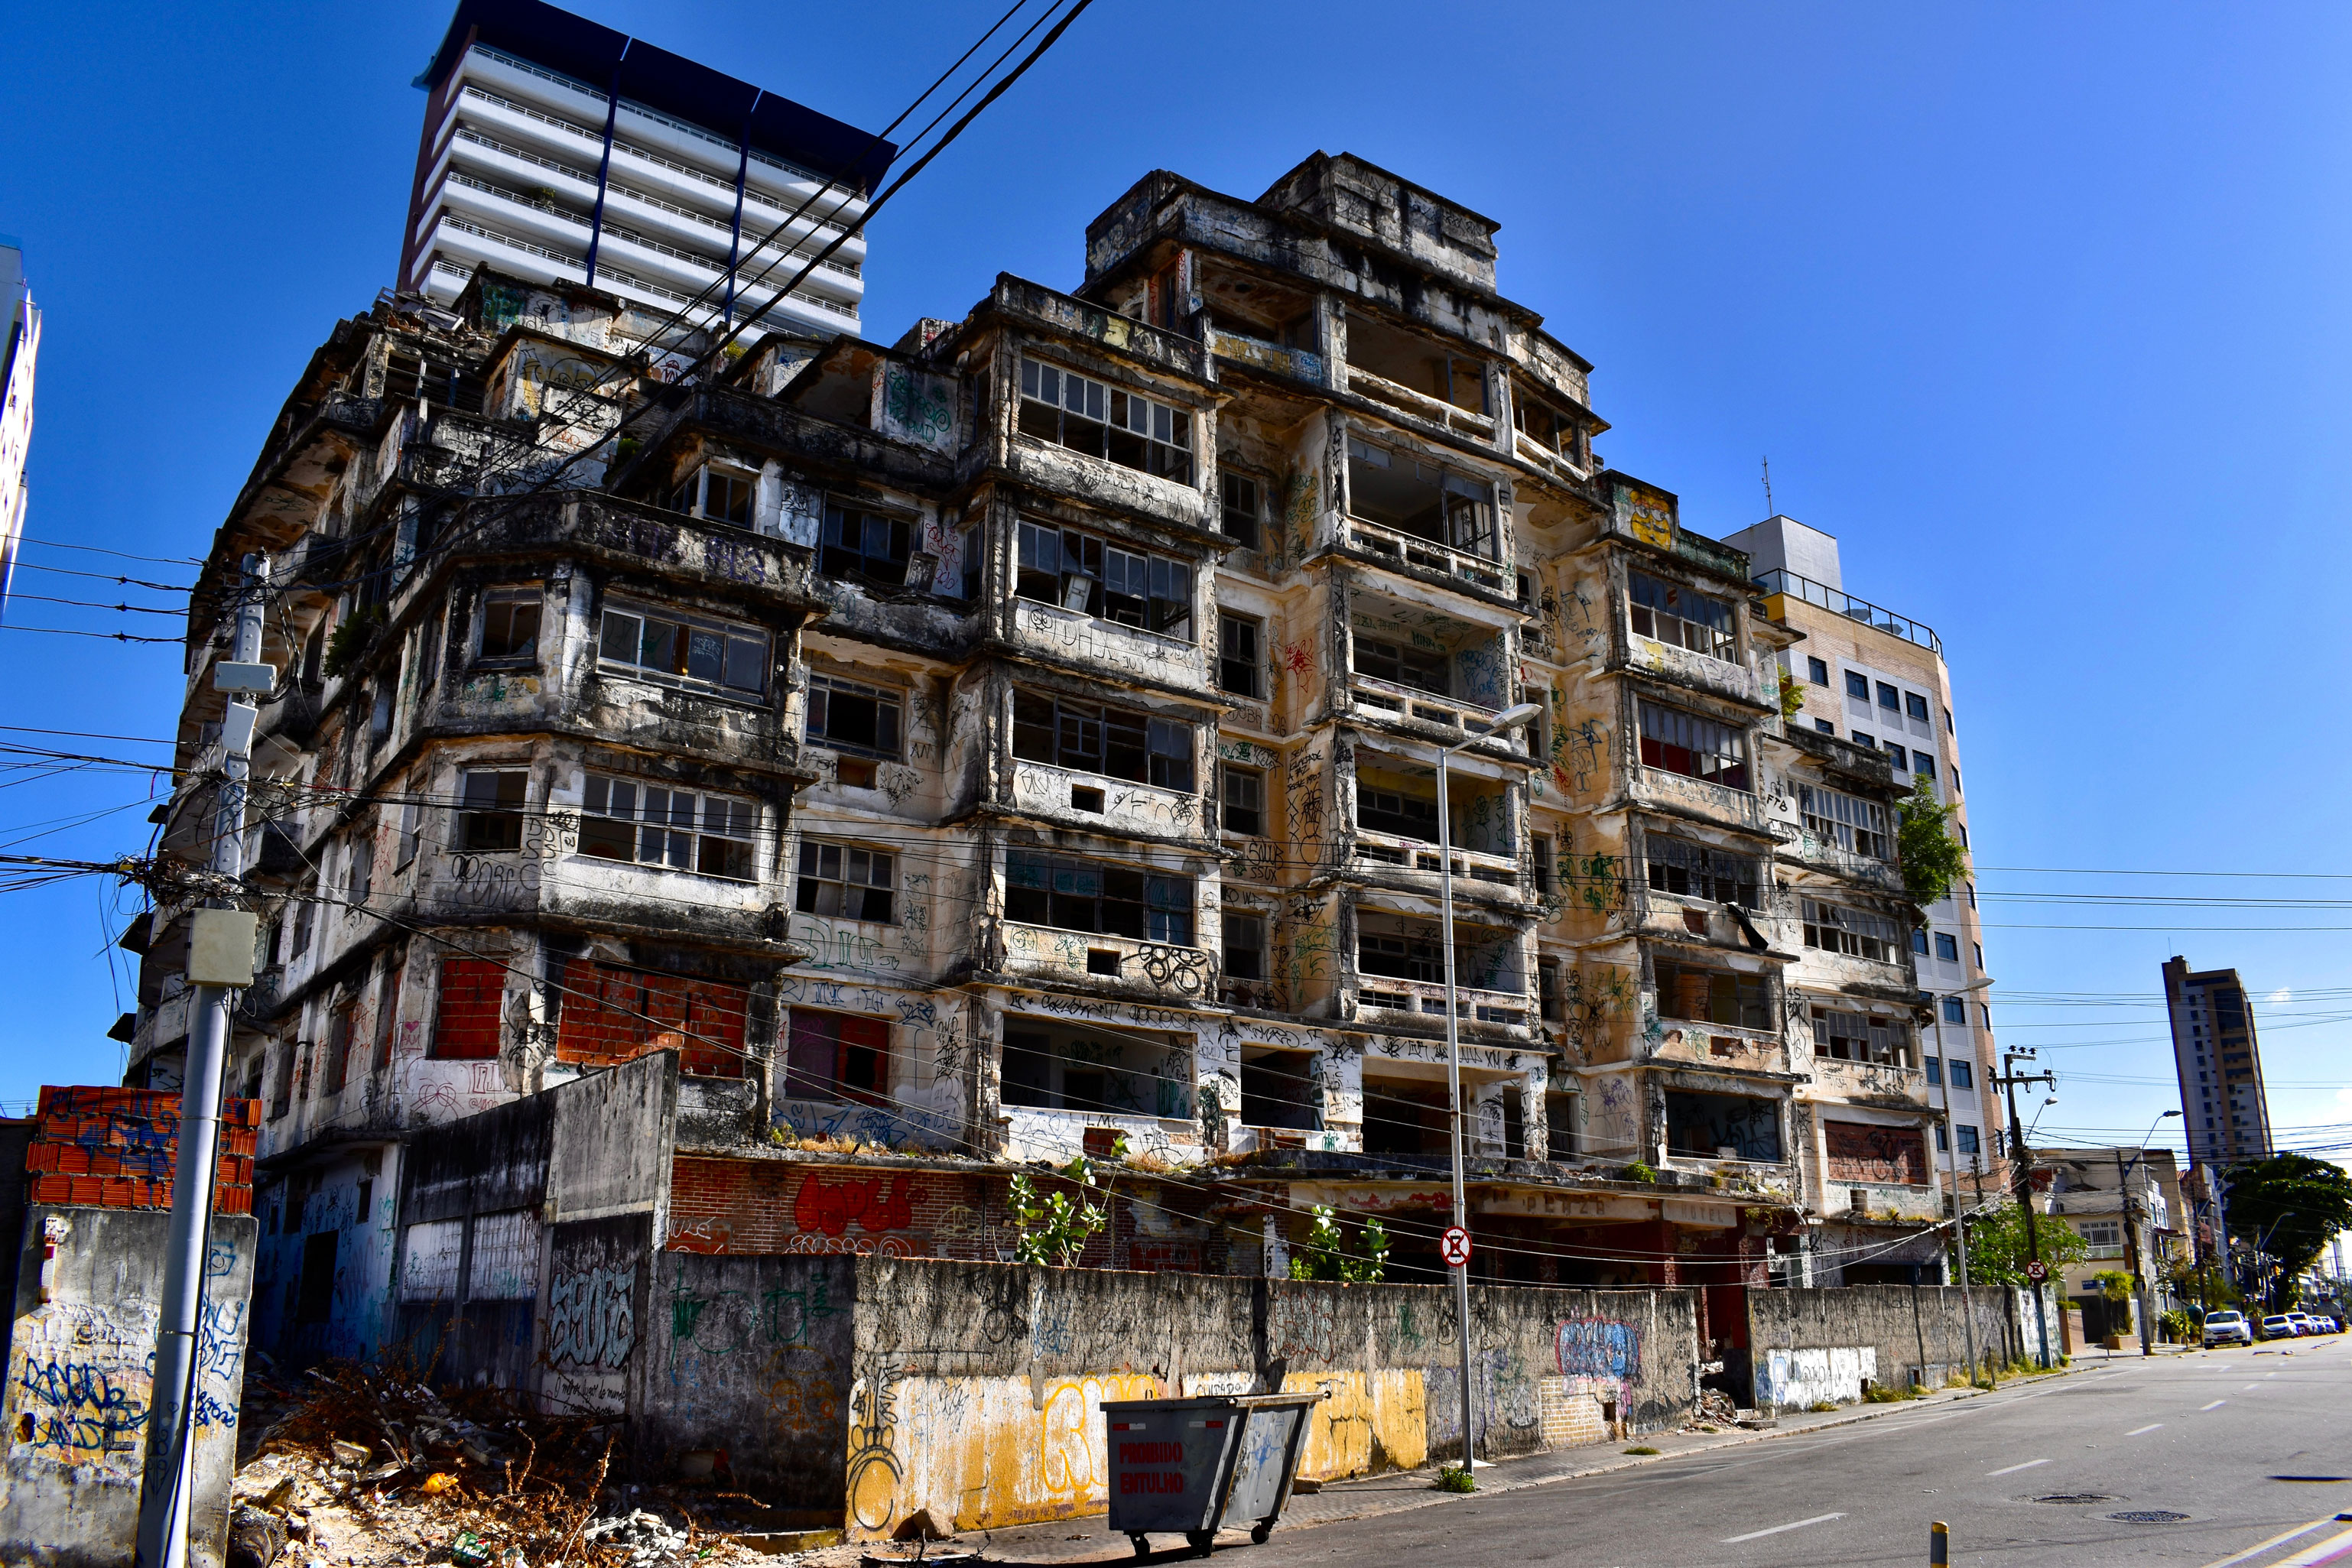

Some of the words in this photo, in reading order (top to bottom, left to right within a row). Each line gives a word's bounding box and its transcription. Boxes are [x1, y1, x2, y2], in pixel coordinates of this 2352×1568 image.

[1683, 1204, 1723, 1223] HOTEL
[1119, 1441, 1184, 1465] PROIBIDO
[1119, 1472, 1184, 1495] ENTULHO
